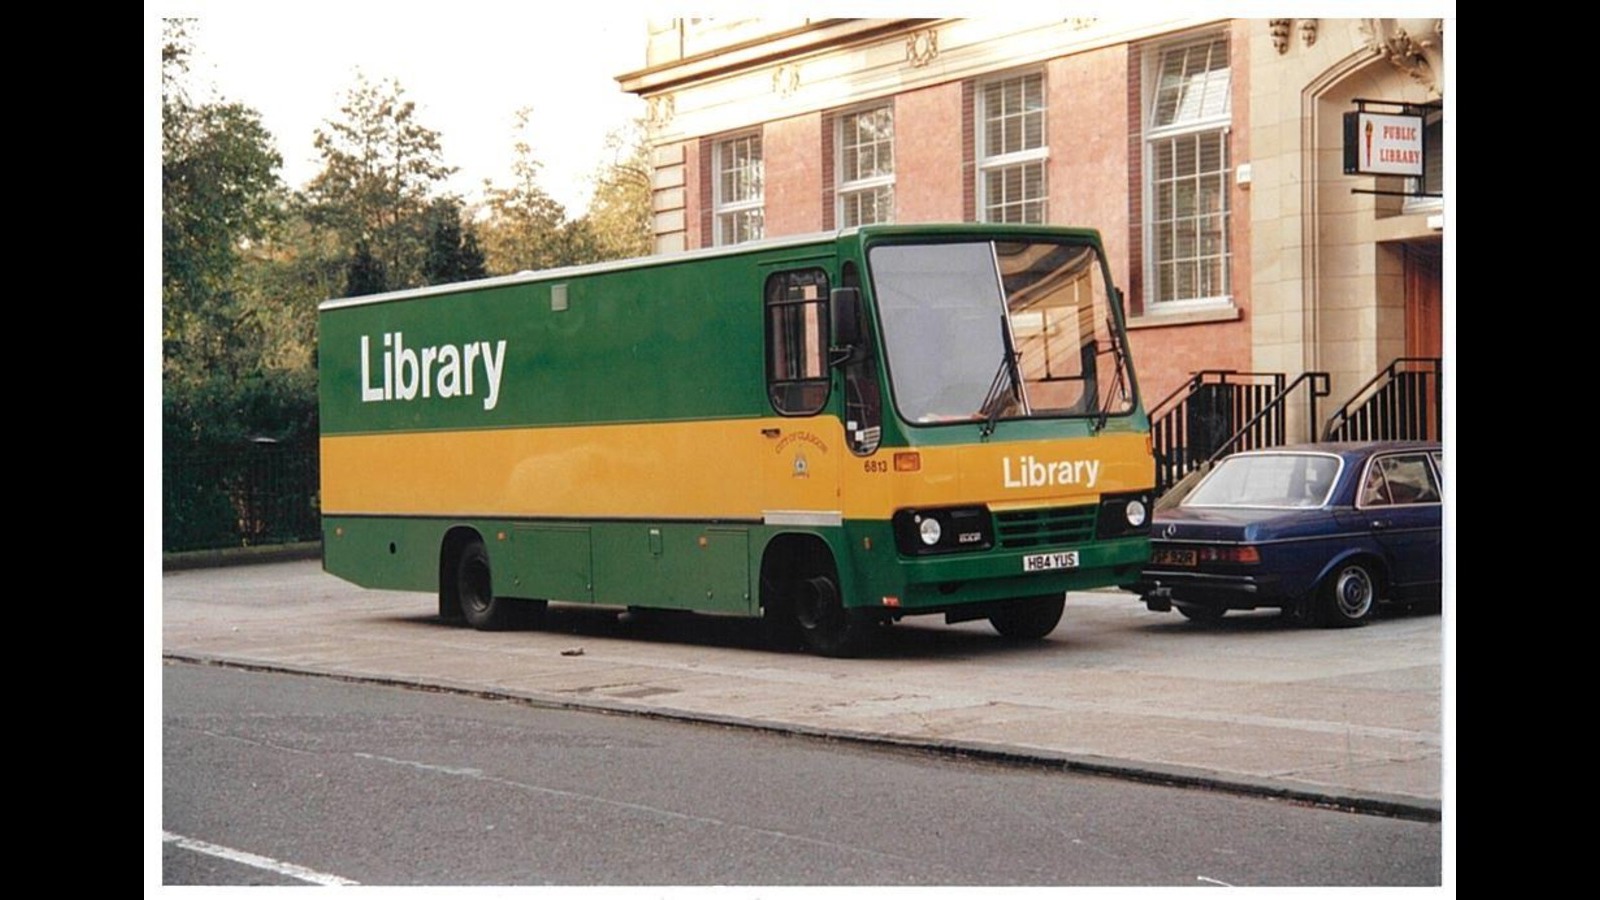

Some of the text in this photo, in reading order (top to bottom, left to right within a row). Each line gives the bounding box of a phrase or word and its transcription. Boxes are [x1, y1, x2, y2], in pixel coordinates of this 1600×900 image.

[1383, 125, 1417, 141] PUBLIC
[1380, 148, 1420, 164] LIBRARY
[361, 332, 507, 410] Library
[864, 460, 888, 473] 6813
[1003, 455, 1099, 488] Library
[1028, 553, 1075, 569] H84 YUS
